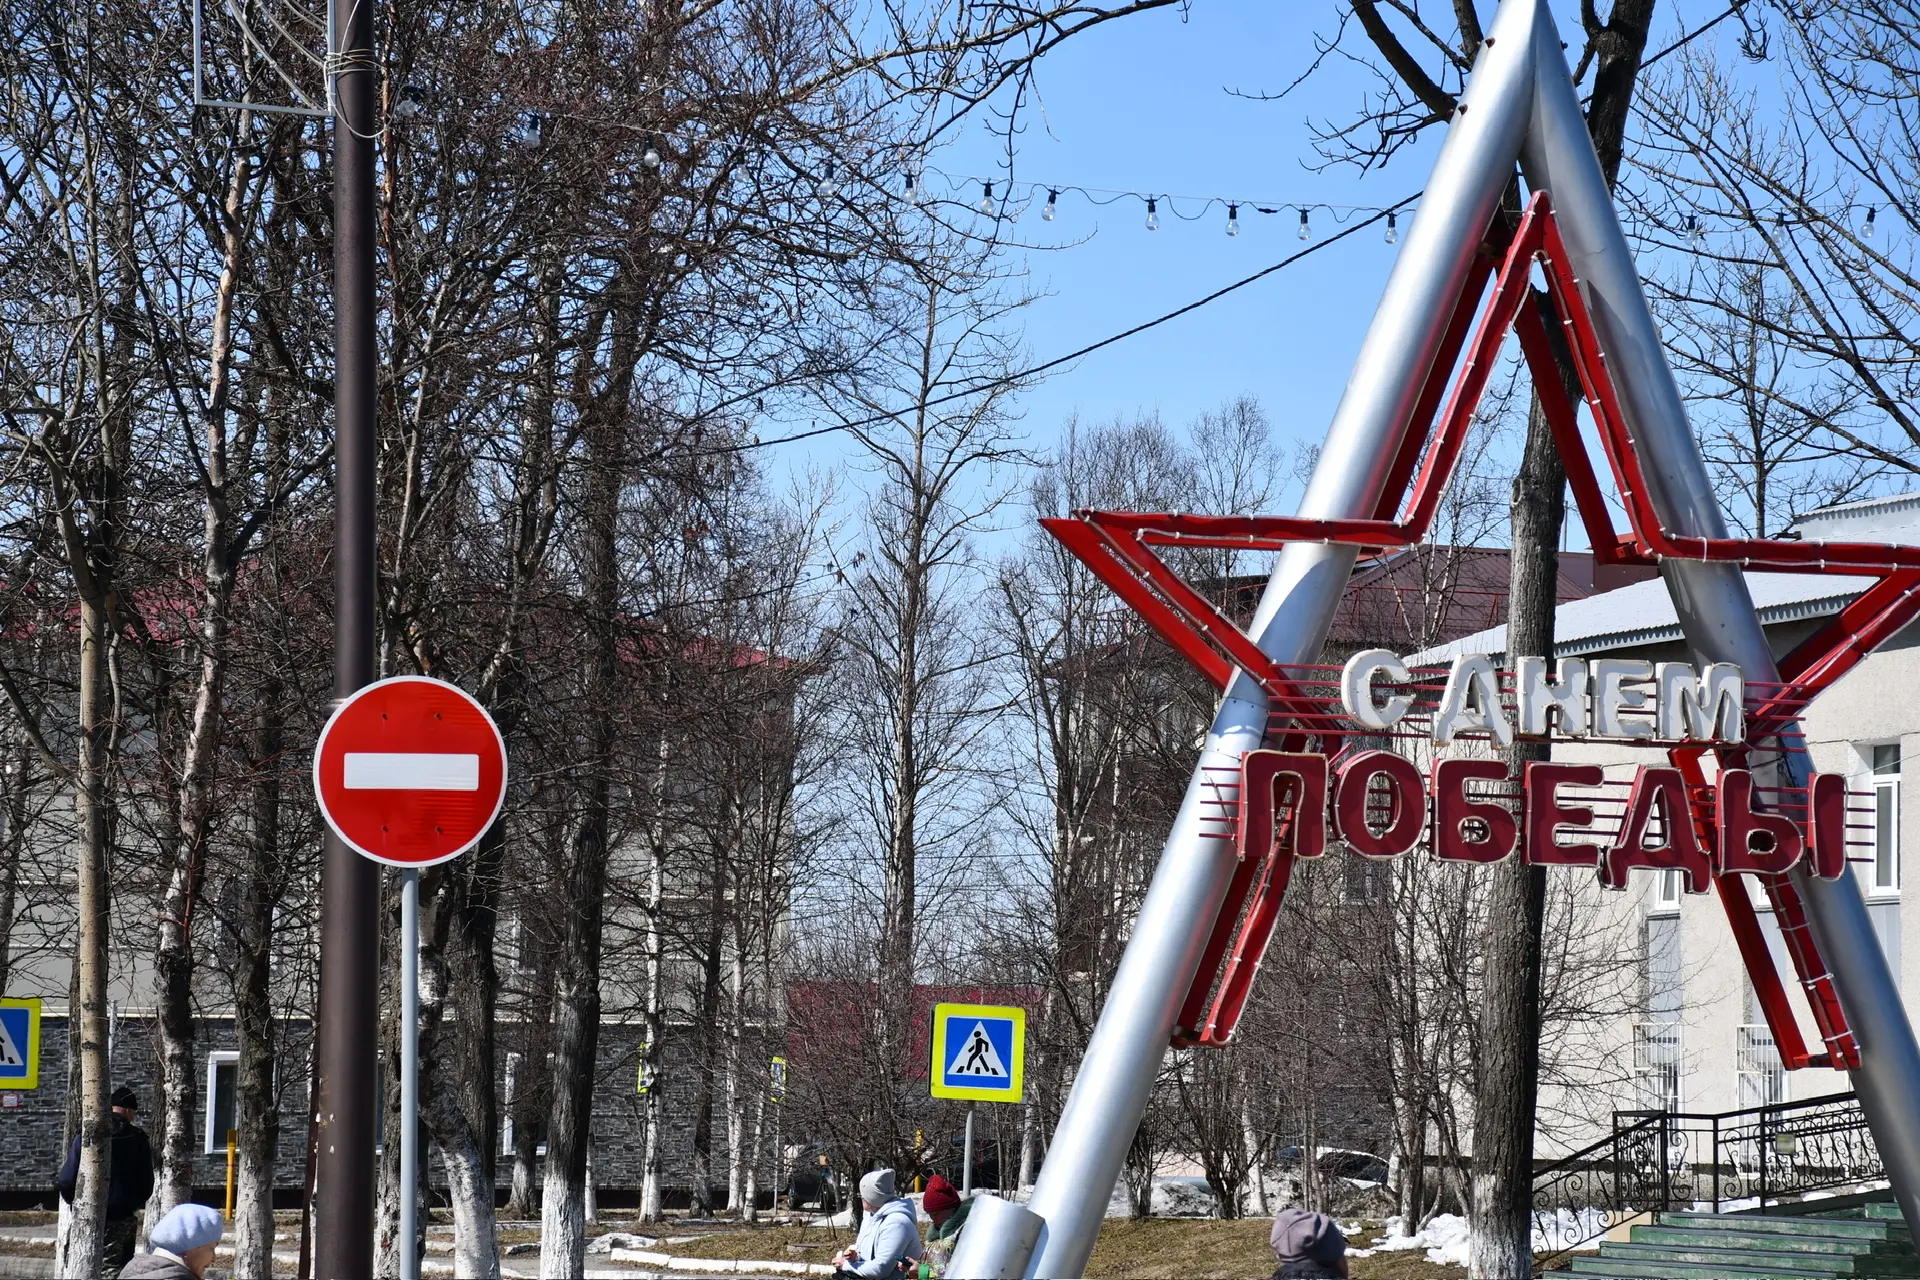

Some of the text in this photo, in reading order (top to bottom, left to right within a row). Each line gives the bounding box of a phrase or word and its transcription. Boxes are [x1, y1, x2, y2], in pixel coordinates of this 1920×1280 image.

[1341, 649, 1746, 749] С ДНЕМ
[1238, 750, 1848, 894] ПОБЕДЫ
